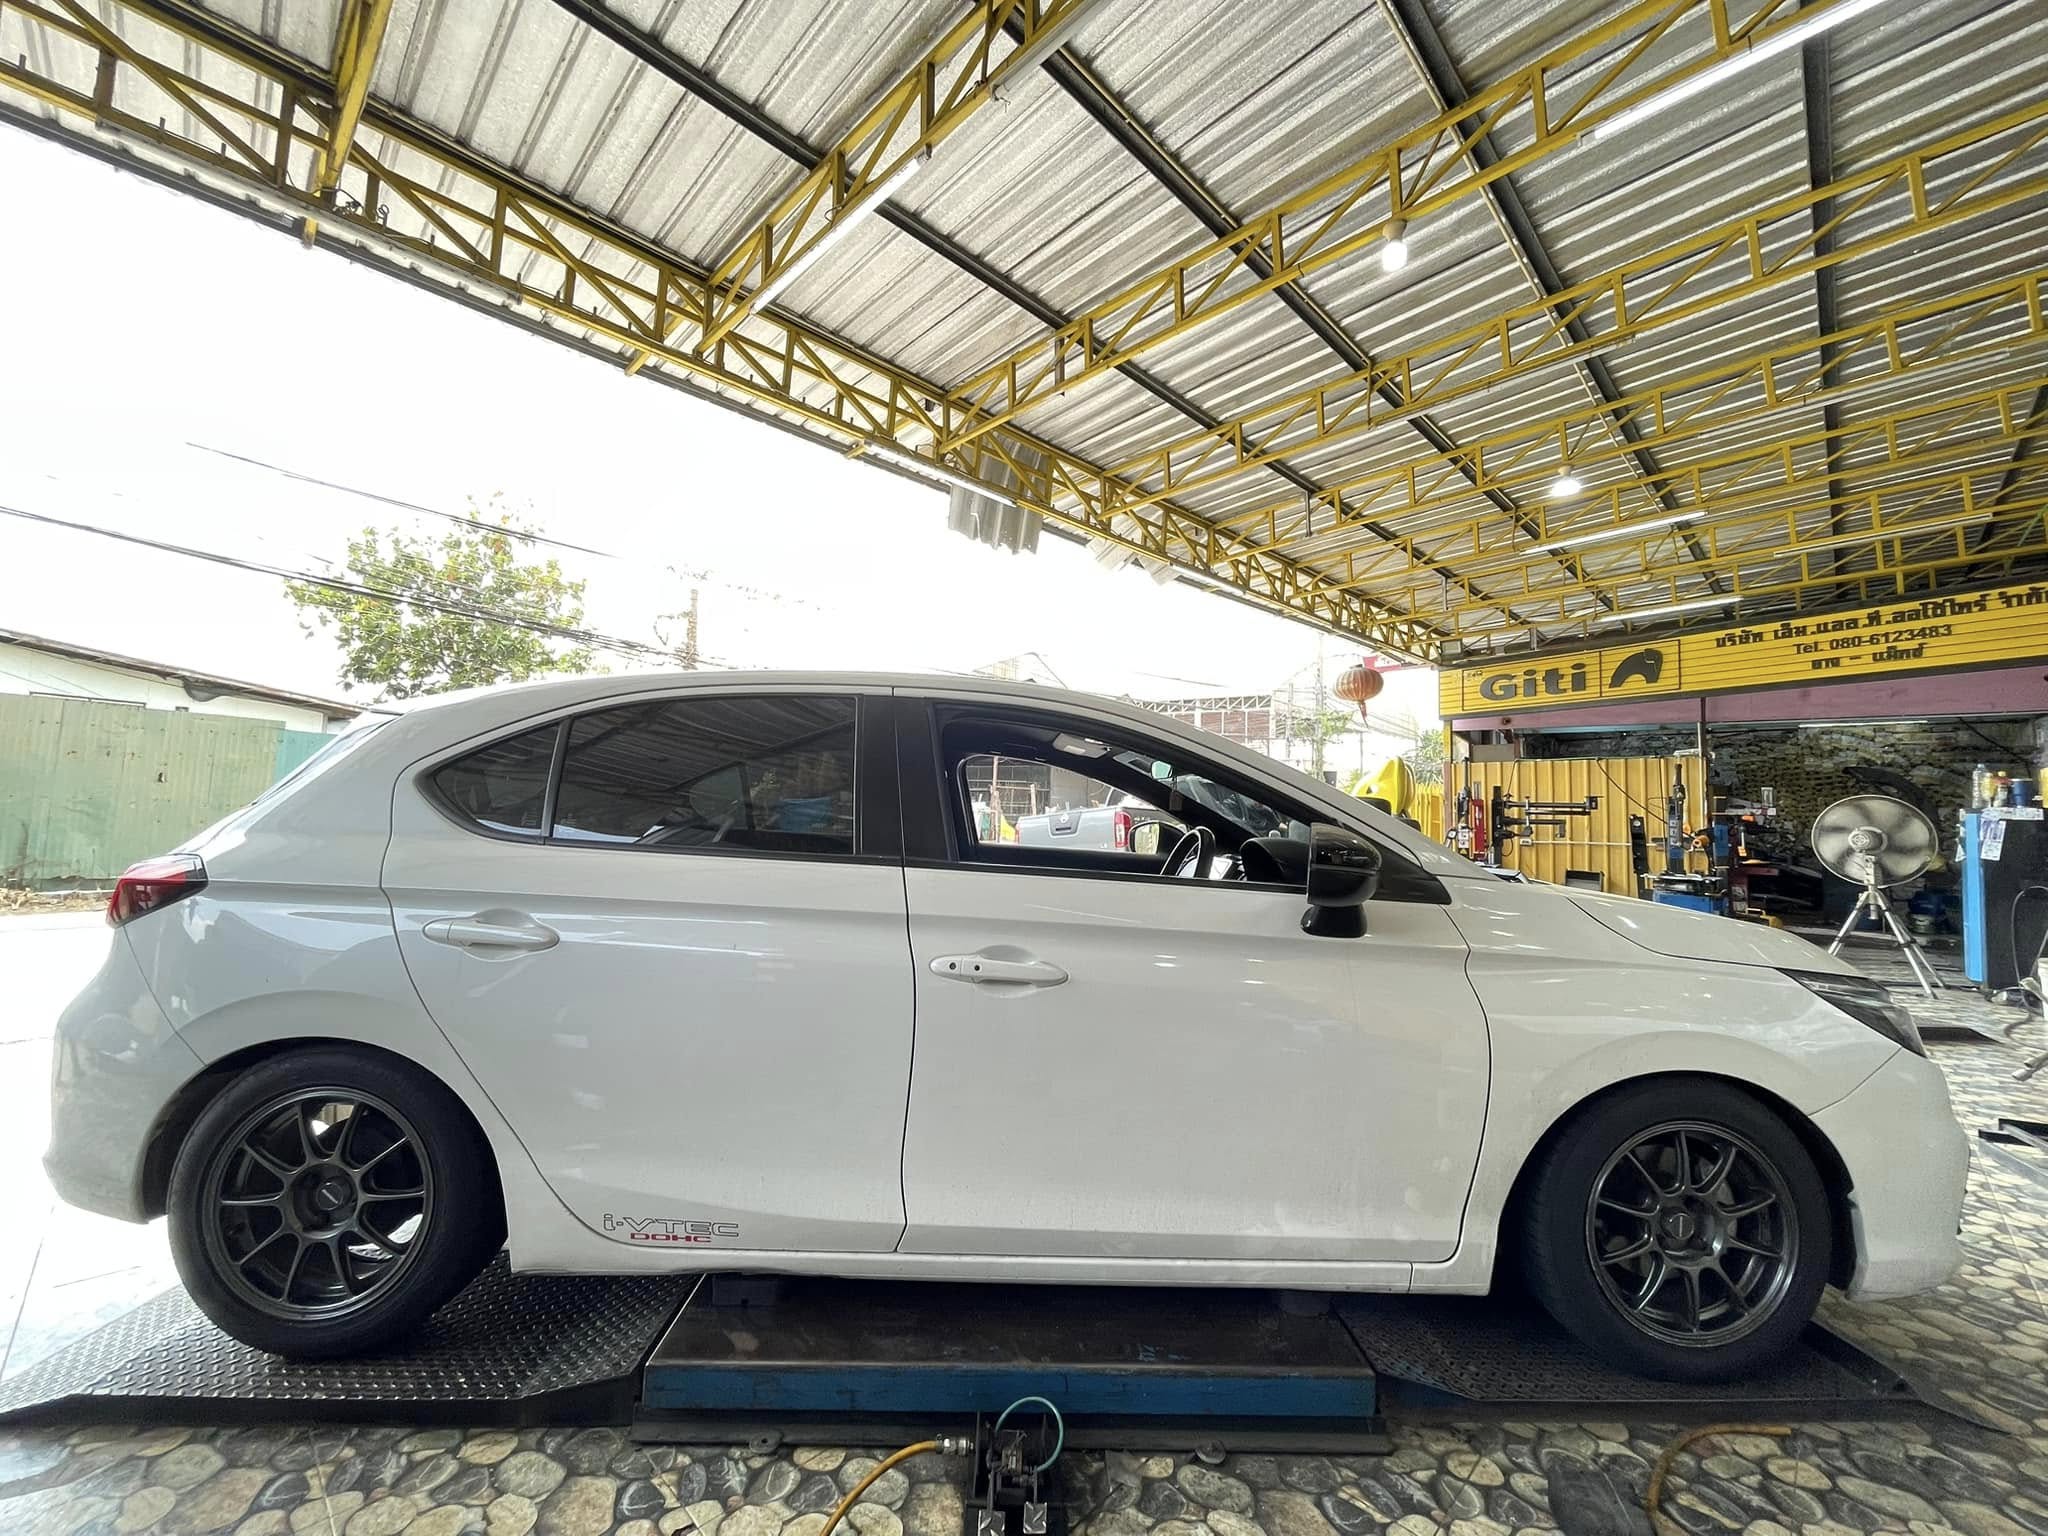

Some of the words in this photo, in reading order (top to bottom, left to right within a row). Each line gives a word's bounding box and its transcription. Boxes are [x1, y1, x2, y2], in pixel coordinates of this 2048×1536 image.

[1998, 586, 2048, 608] จำกั
[1793, 641, 1824, 655] Tel.
[1829, 624, 1952, 650] 080-6123483
[1479, 663, 1586, 700] Giti
[630, 1232, 712, 1243] DOHC
